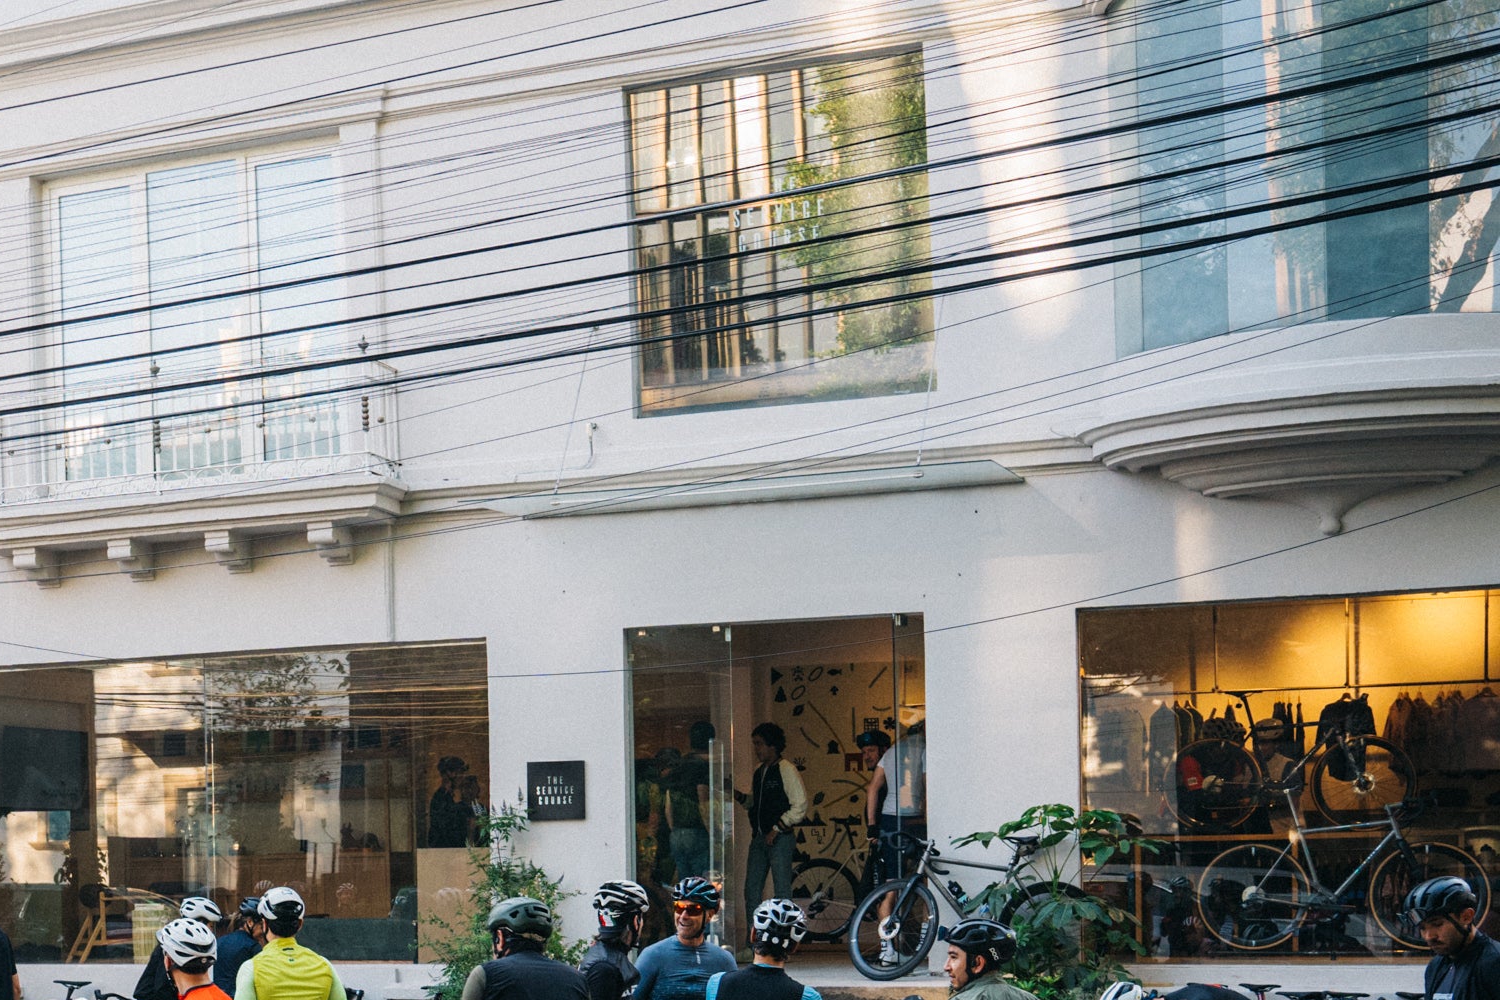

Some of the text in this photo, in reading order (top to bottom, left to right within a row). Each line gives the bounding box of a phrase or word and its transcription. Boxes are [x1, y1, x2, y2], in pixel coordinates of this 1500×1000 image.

[547, 775, 563, 785] THE
[536, 786, 575, 796] SERVICE
[538, 796, 573, 806] COURSE
